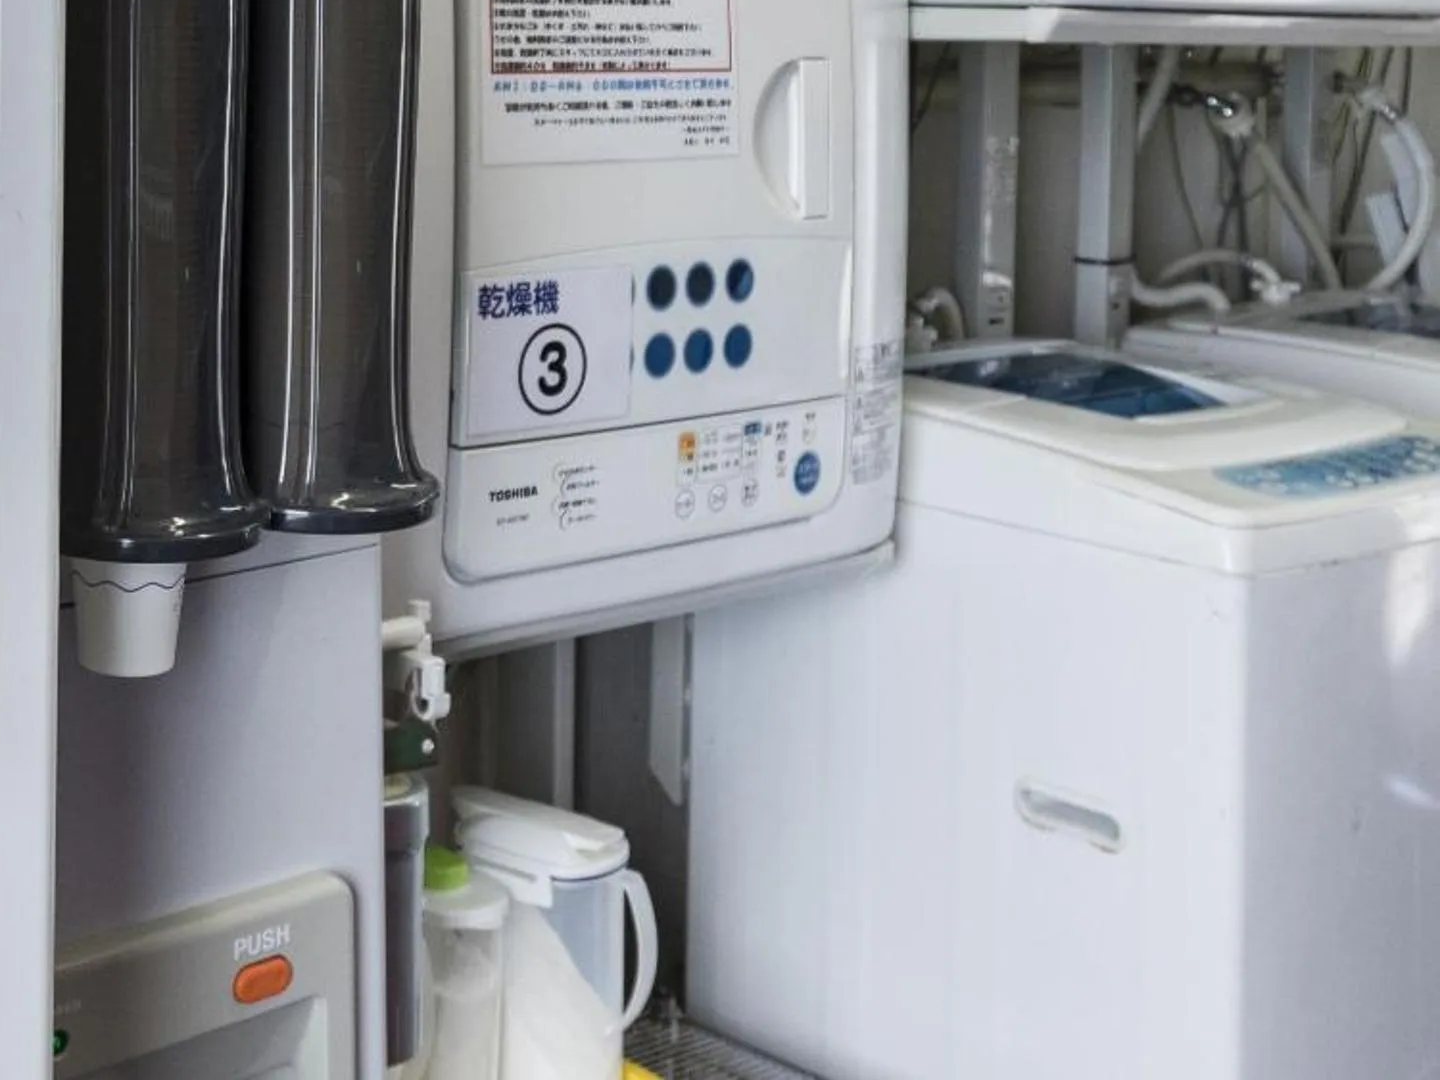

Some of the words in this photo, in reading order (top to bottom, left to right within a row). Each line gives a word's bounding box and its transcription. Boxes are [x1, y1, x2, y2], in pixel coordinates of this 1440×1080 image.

[477, 279, 561, 321] 乾燥機
[488, 485, 539, 503] TOSHIBA
[234, 923, 291, 960] PUSH
